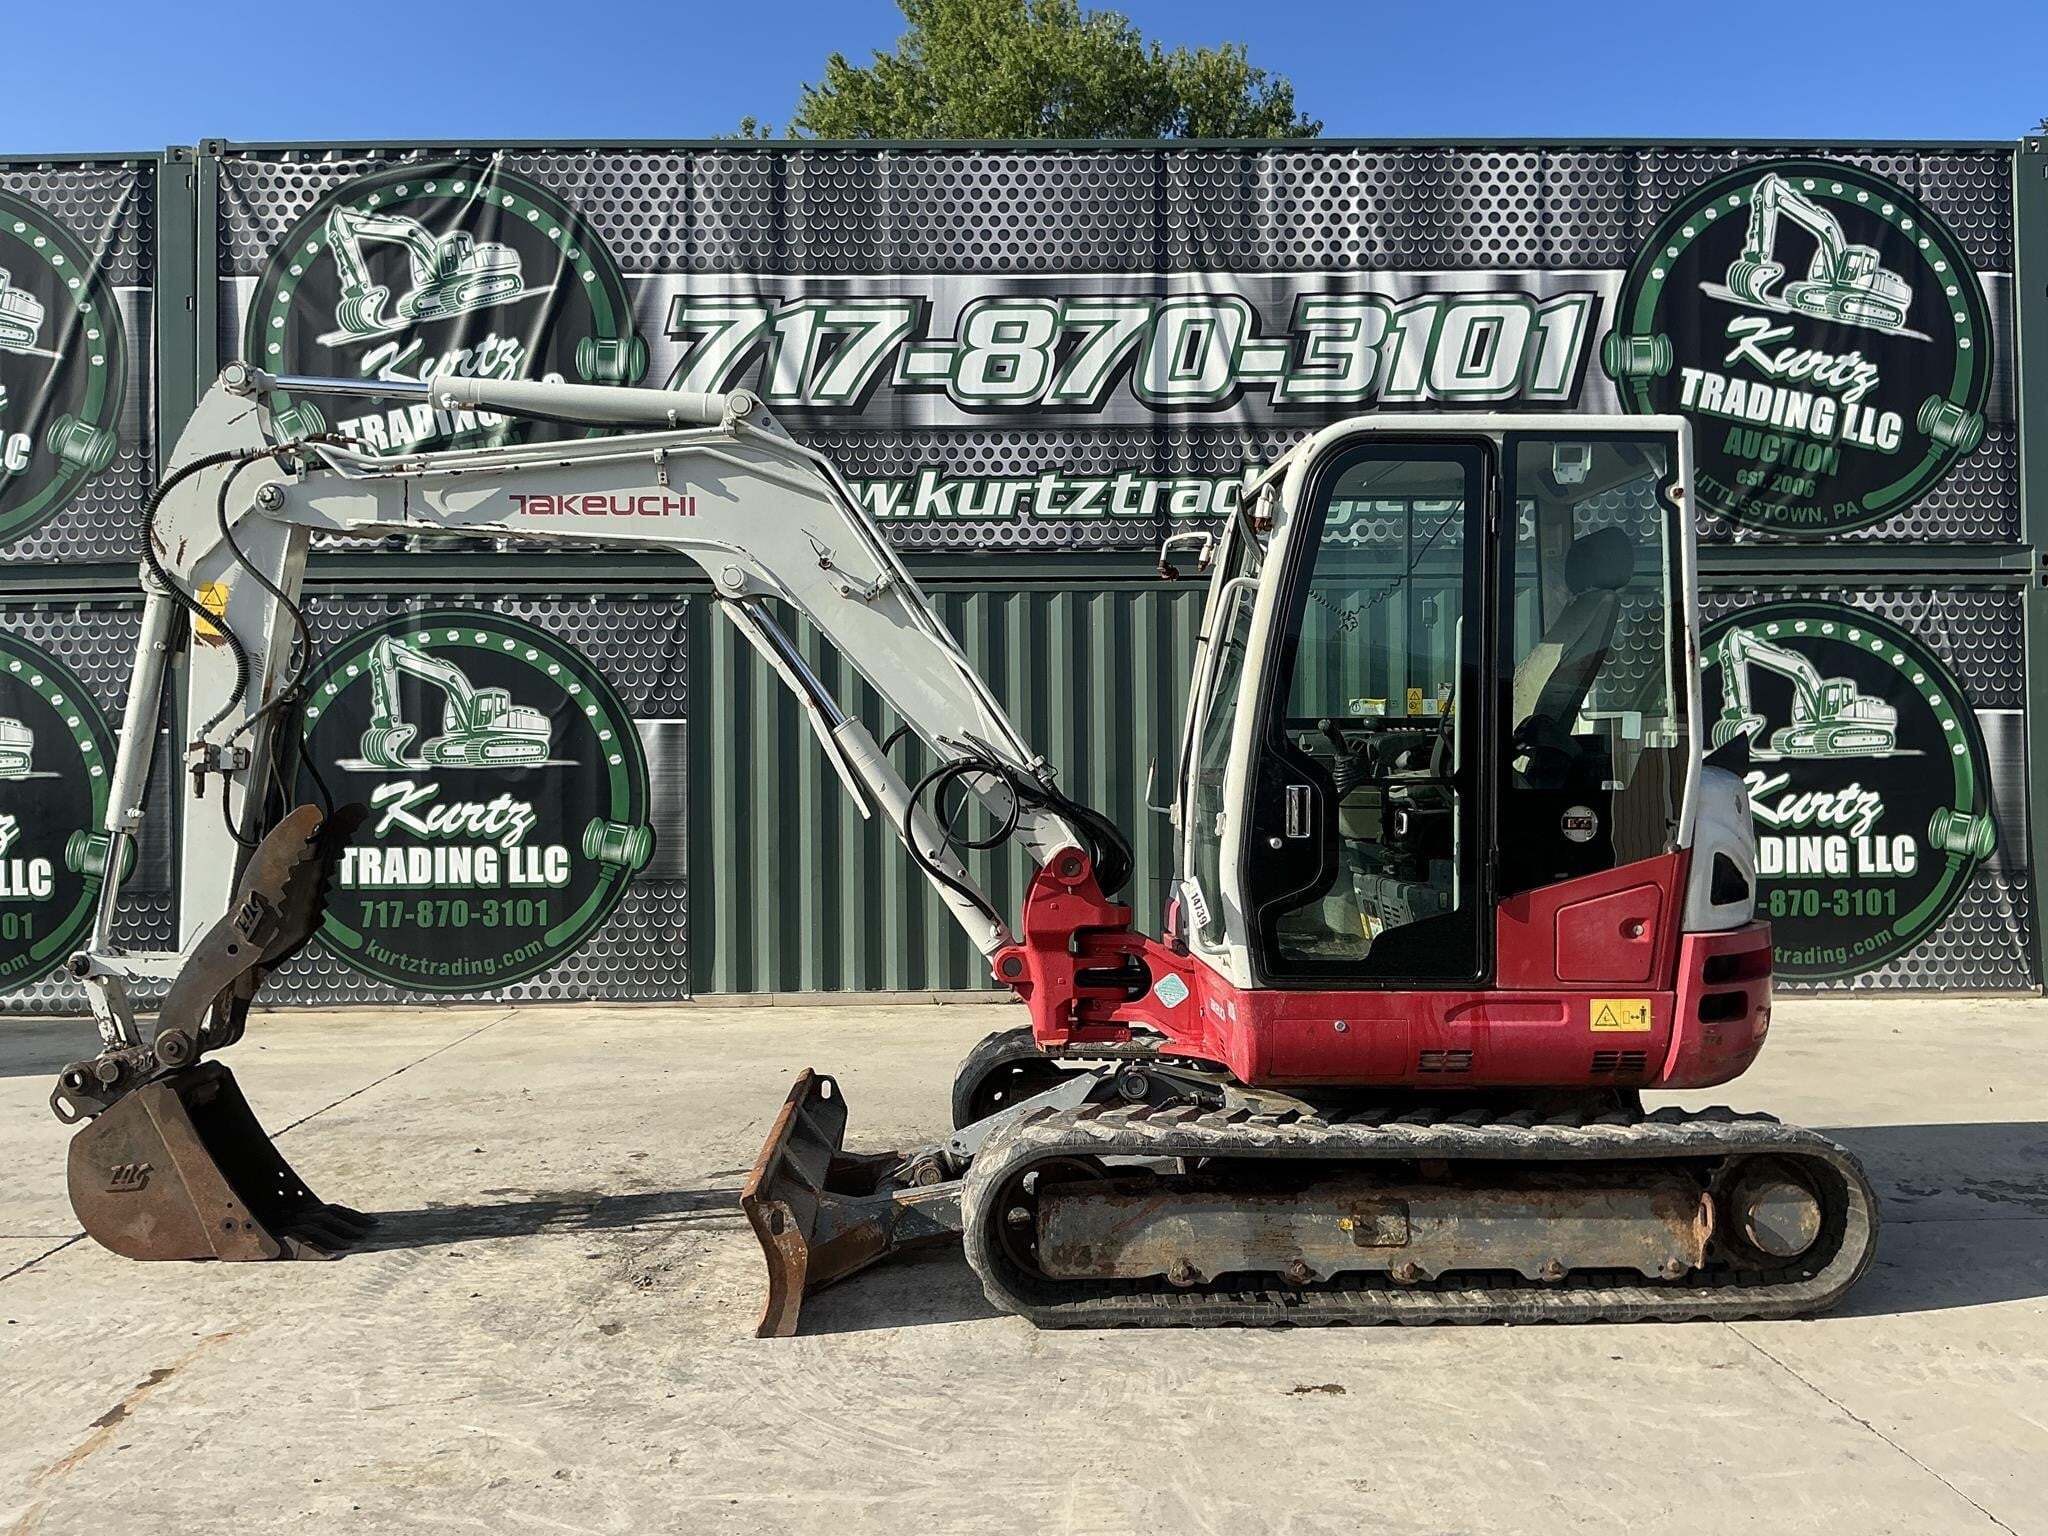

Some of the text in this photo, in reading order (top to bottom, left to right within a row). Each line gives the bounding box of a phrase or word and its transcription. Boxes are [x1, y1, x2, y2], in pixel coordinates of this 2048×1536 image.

[665, 295, 1598, 410] 717-870-3101
[1725, 315, 1880, 403] Kurtz
[1680, 366, 1903, 451] TRADING LLC
[1723, 427, 1841, 476] AUCTION
[508, 494, 696, 517] TAKEUCHI
[848, 467, 1260, 517] w.kurtztrad
[1770, 473, 1817, 498] 2006
[1833, 501, 1860, 520] PA
[371, 780, 536, 848] Kurtz
[1744, 770, 1885, 838] Kurtz
[340, 845, 570, 887] TRADING LLC
[1753, 834, 1917, 875] DING LLC
[360, 899, 549, 929] 717-870-3101
[1190, 892, 1208, 927] 14739
[1758, 888, 1897, 917] -870-3101
[364, 938, 544, 977] kurtztrading.com
[1774, 929, 1893, 965] trading.com
